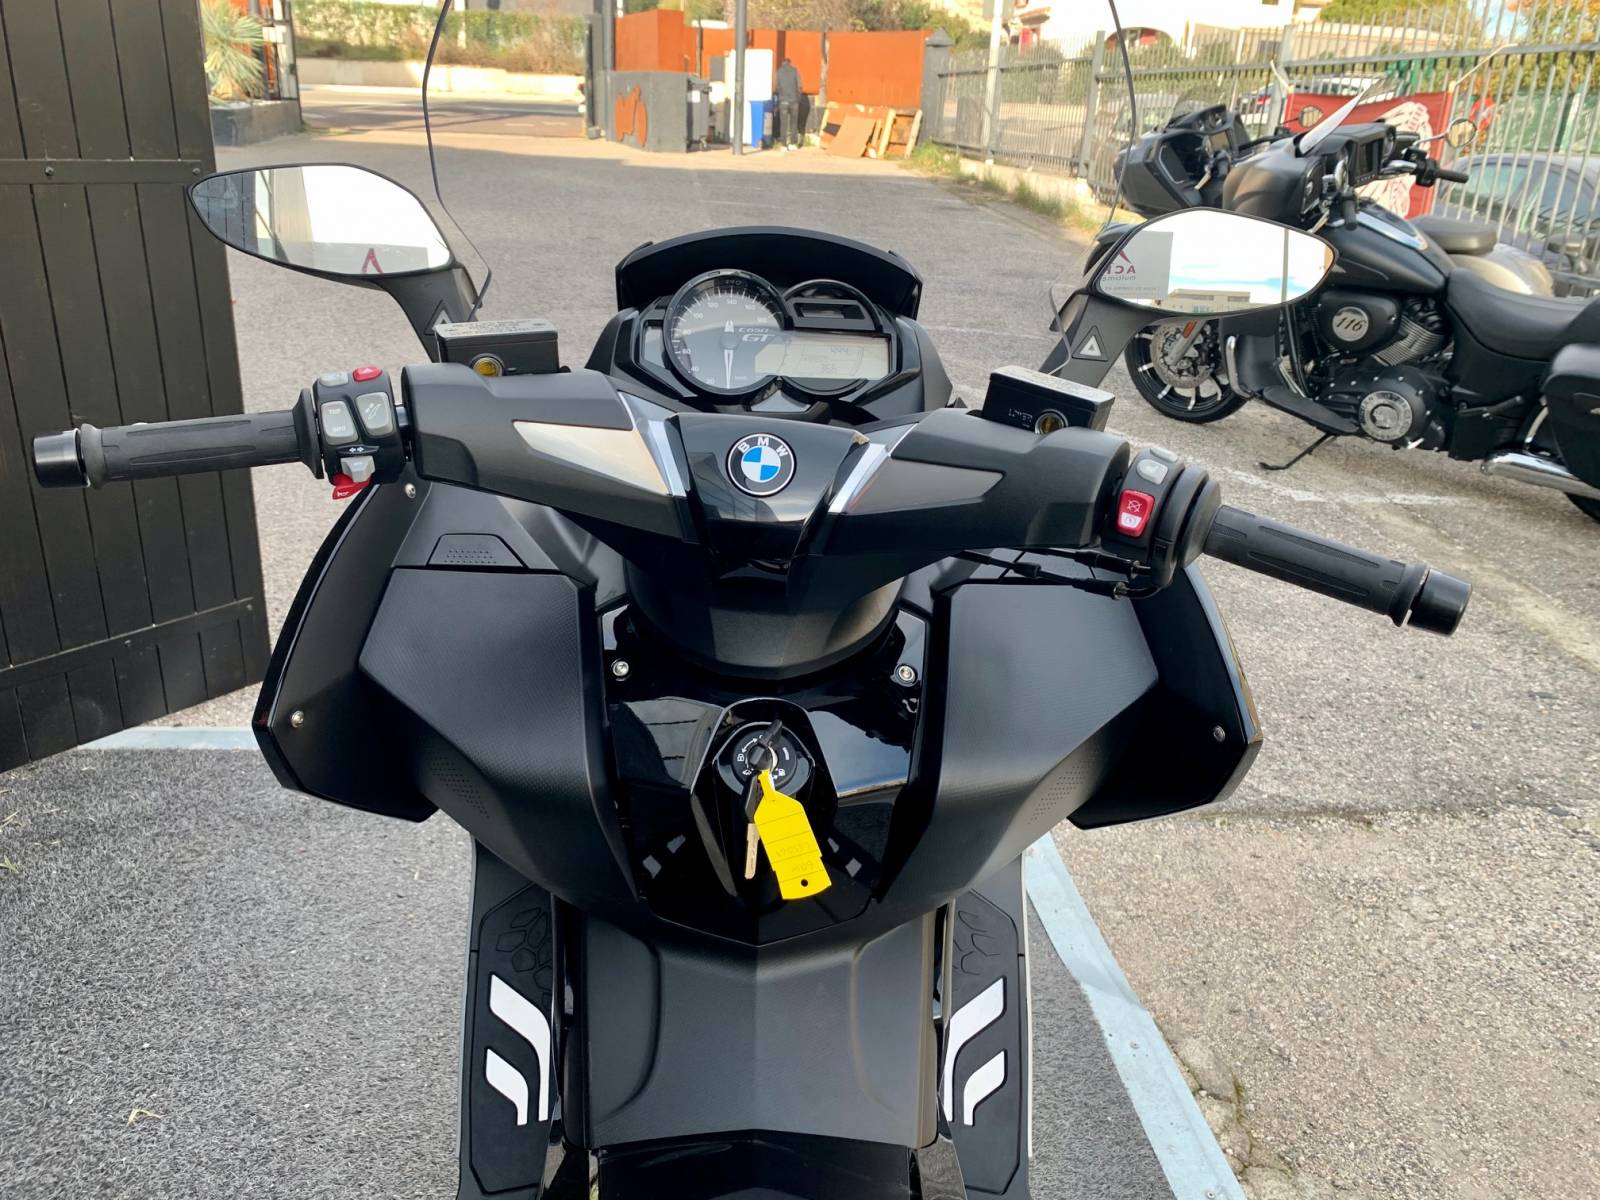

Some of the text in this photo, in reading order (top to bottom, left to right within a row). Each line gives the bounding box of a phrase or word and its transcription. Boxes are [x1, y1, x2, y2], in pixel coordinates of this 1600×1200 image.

[1336, 317, 1364, 331] 116
[742, 334, 775, 342] GT
[737, 437, 789, 457] BMW
